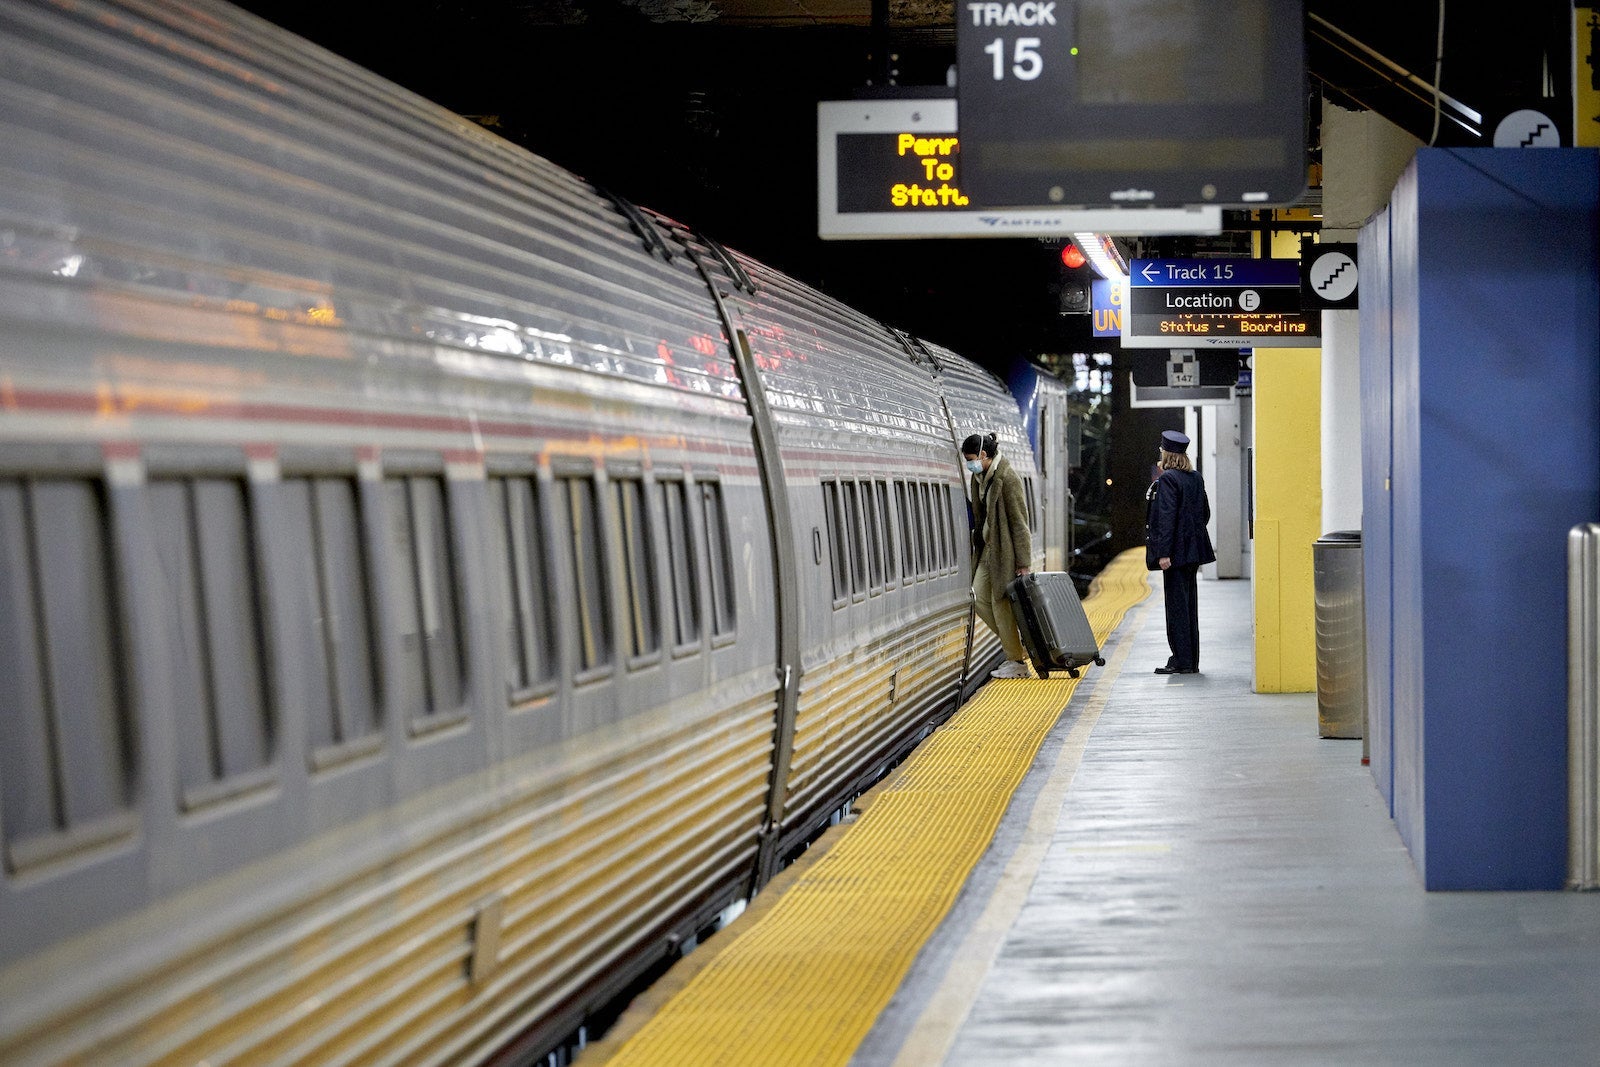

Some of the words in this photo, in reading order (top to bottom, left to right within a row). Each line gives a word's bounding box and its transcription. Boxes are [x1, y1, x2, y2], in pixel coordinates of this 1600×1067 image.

[967, 1, 1057, 26] TRACK
[984, 37, 1043, 81] 15
[921, 158, 954, 181] To
[1166, 264, 1207, 280] Track
[1213, 264, 1234, 280] 15
[1166, 293, 1233, 308] Location
[1245, 293, 1254, 308] E
[1160, 320, 1209, 333] Status
[1240, 320, 1306, 333] Boarding
